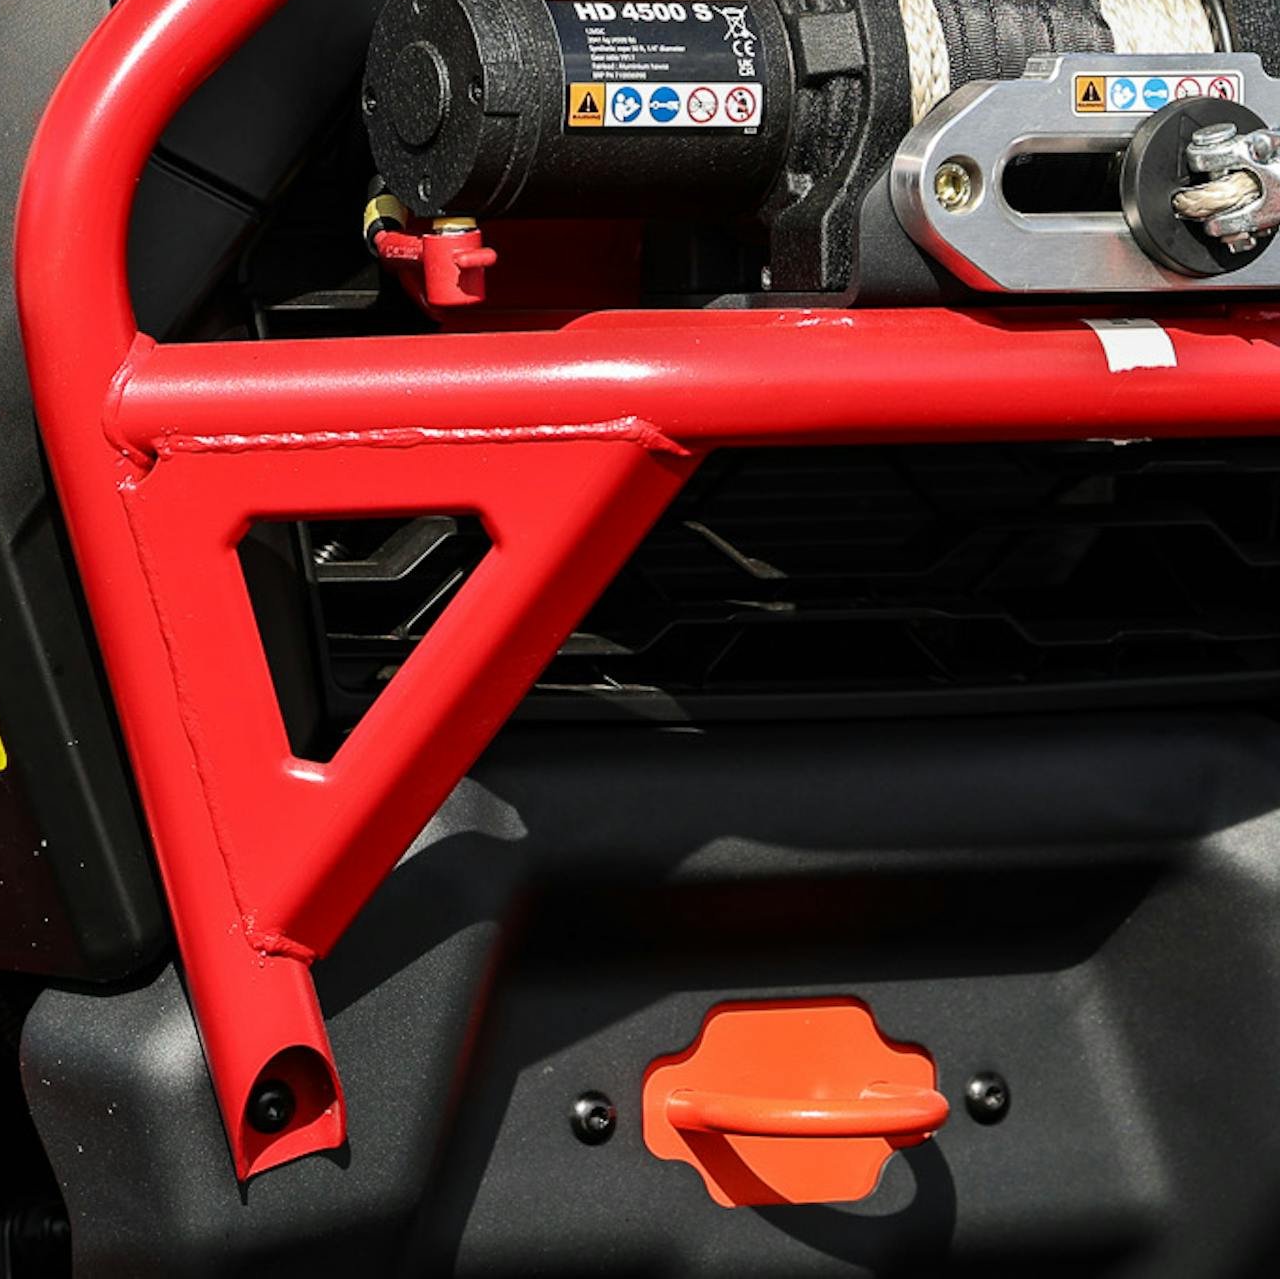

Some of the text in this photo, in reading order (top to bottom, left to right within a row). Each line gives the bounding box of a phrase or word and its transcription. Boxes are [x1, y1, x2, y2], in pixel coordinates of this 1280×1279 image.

[574, 2, 714, 22] HD 4500 S
